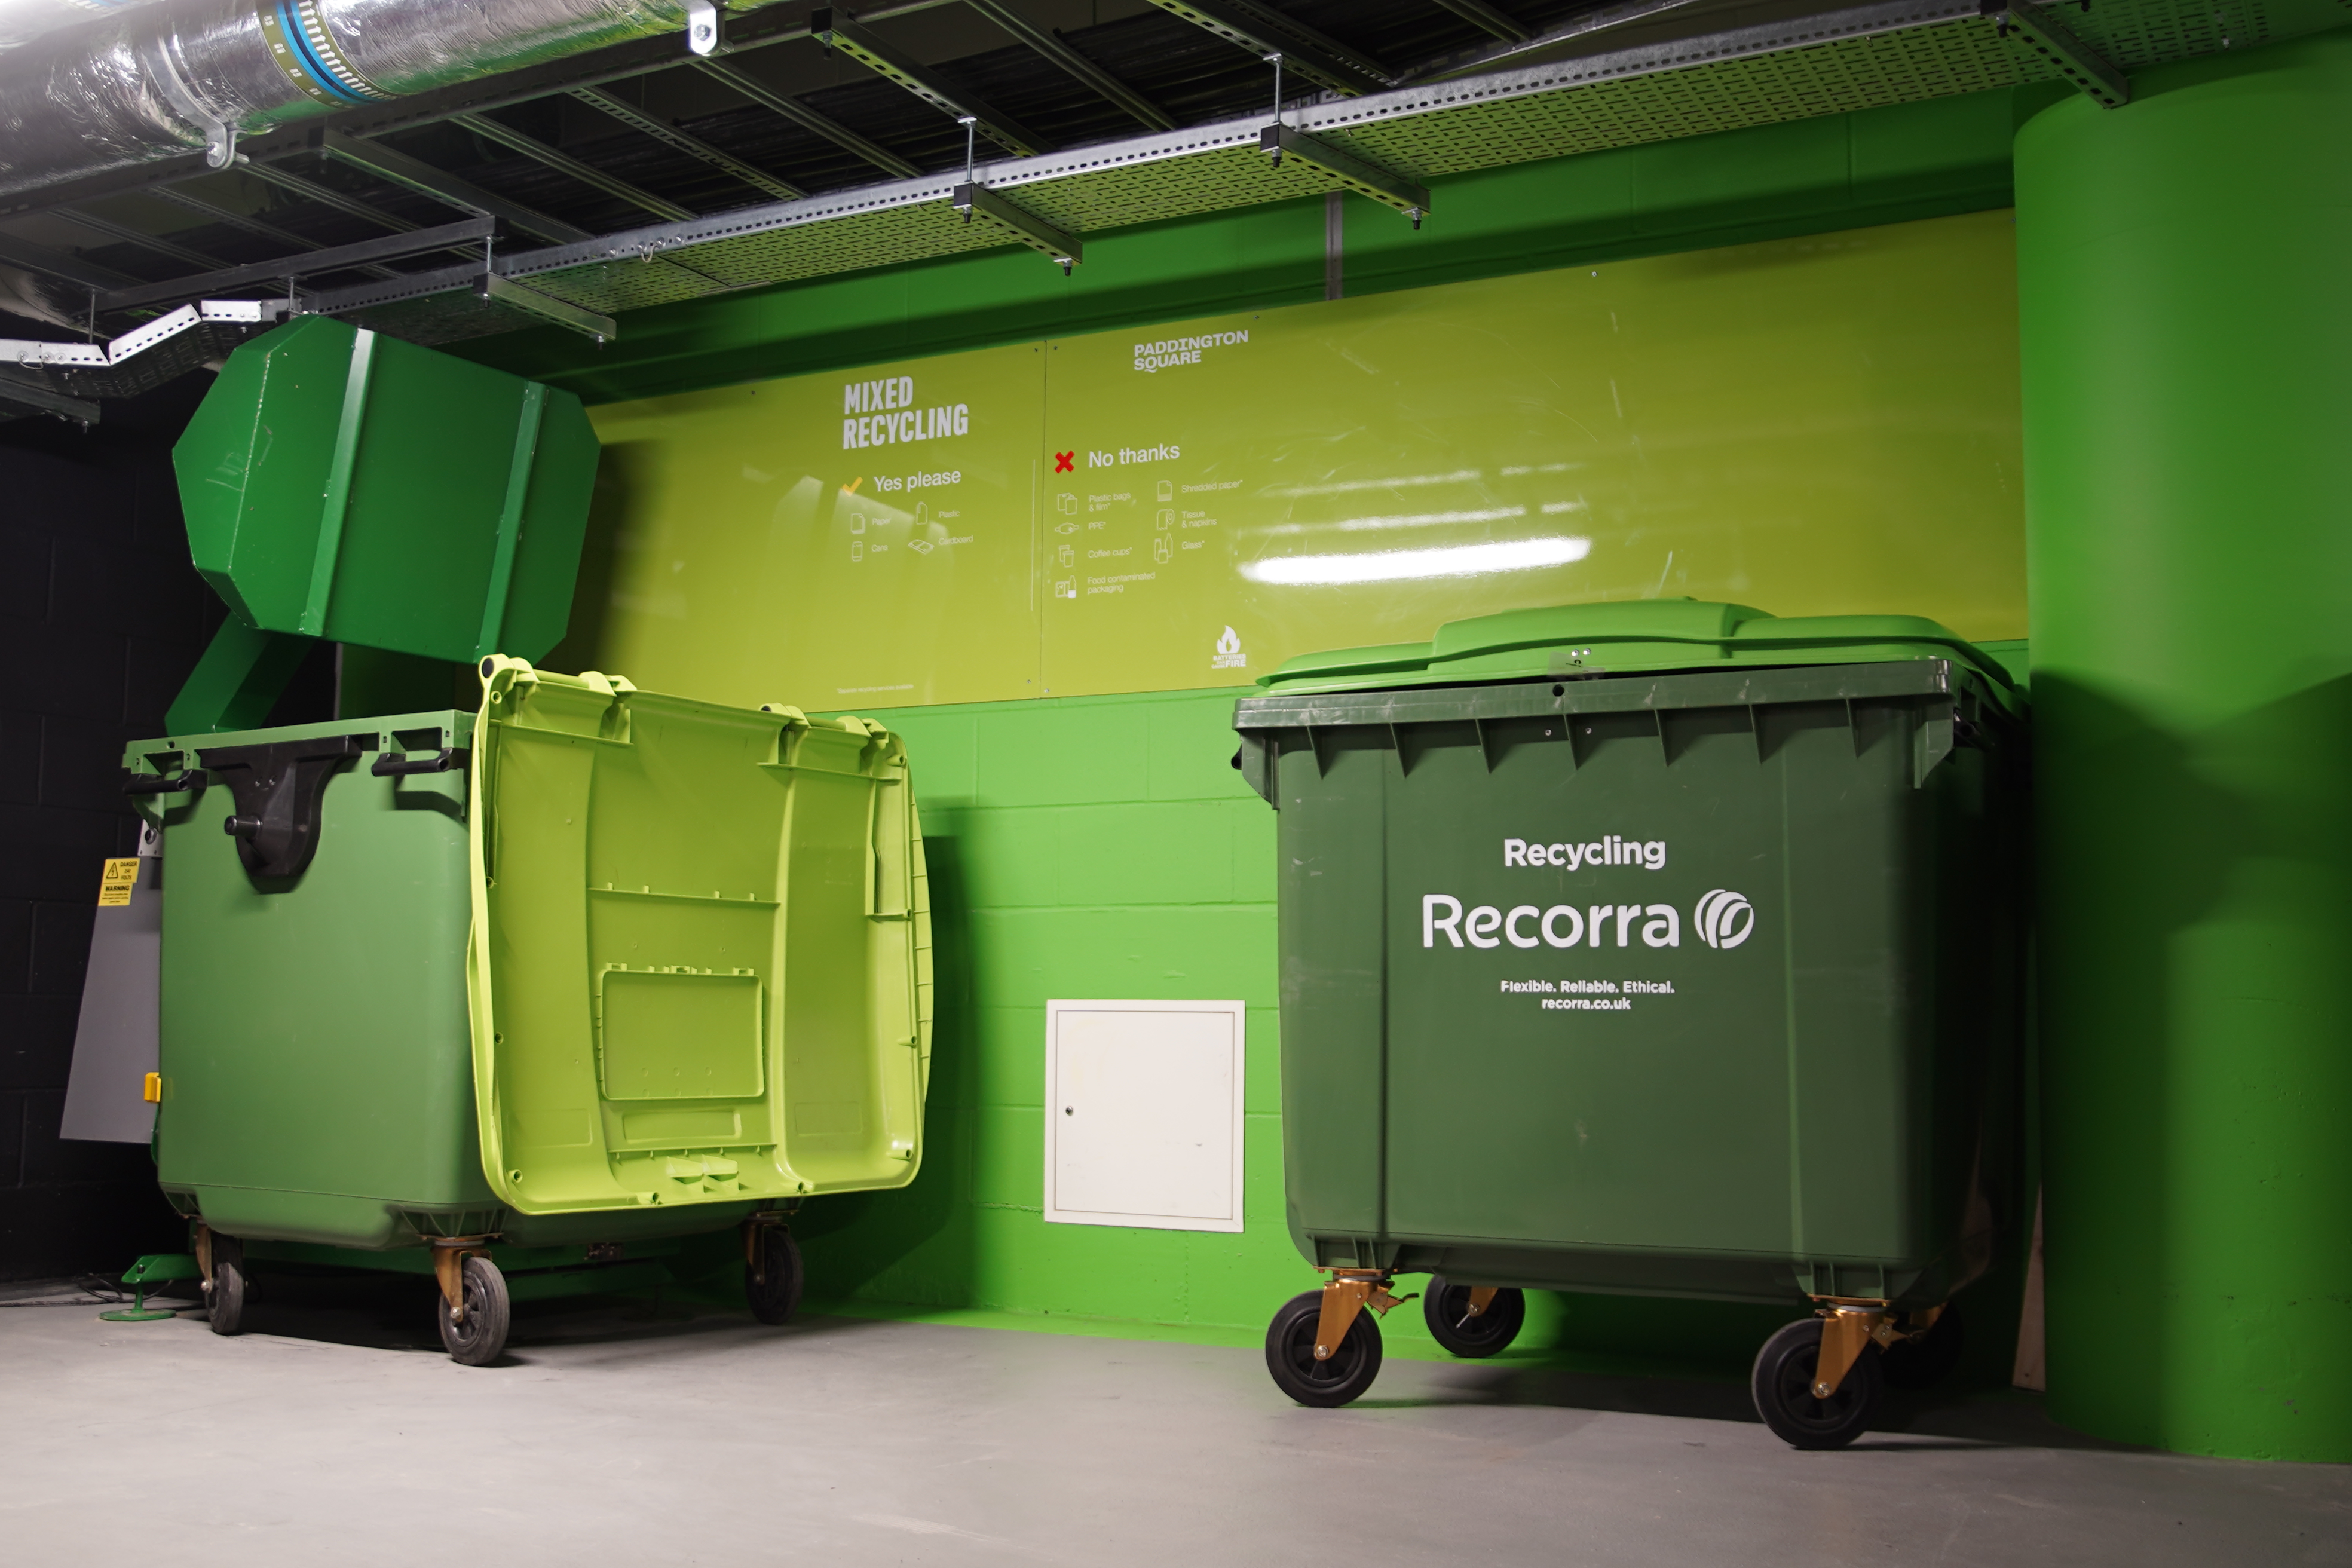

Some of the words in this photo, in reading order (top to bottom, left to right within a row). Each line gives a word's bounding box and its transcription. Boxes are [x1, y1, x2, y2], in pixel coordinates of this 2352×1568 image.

[1135, 330, 1248, 356] PADDINGTON
[1134, 350, 1201, 373] SQUARE
[844, 376, 913, 414] MIXED
[843, 403, 968, 449] RECYCLING
[1089, 451, 1113, 468] No
[1119, 443, 1180, 464] thanks
[874, 476, 902, 491] Yes
[907, 471, 961, 492] please
[1182, 482, 1217, 493] Shredded
[1113, 492, 1132, 501] bags
[1089, 503, 1095, 512] &
[939, 510, 960, 518] Plastic
[1181, 510, 1205, 519] Tissue
[872, 516, 892, 526] Paper
[1182, 519, 1189, 528] &
[1189, 516, 1217, 528] napkins
[938, 535, 973, 546] Cardboard
[872, 544, 888, 553] Cans
[1088, 549, 1111, 558] Coffee
[1088, 576, 1106, 584] Food
[1107, 572, 1155, 583] contaminated
[1088, 584, 1124, 595] packaging
[1226, 659, 1246, 667] FIRE
[1505, 836, 1665, 871] Recycling
[1423, 895, 1679, 948] Recorra
[1501, 980, 1556, 992] Flexible.
[1561, 980, 1619, 993] Reliable.
[1624, 981, 1674, 993] Ethical.
[1542, 997, 1631, 1009] recorra.co.uk
